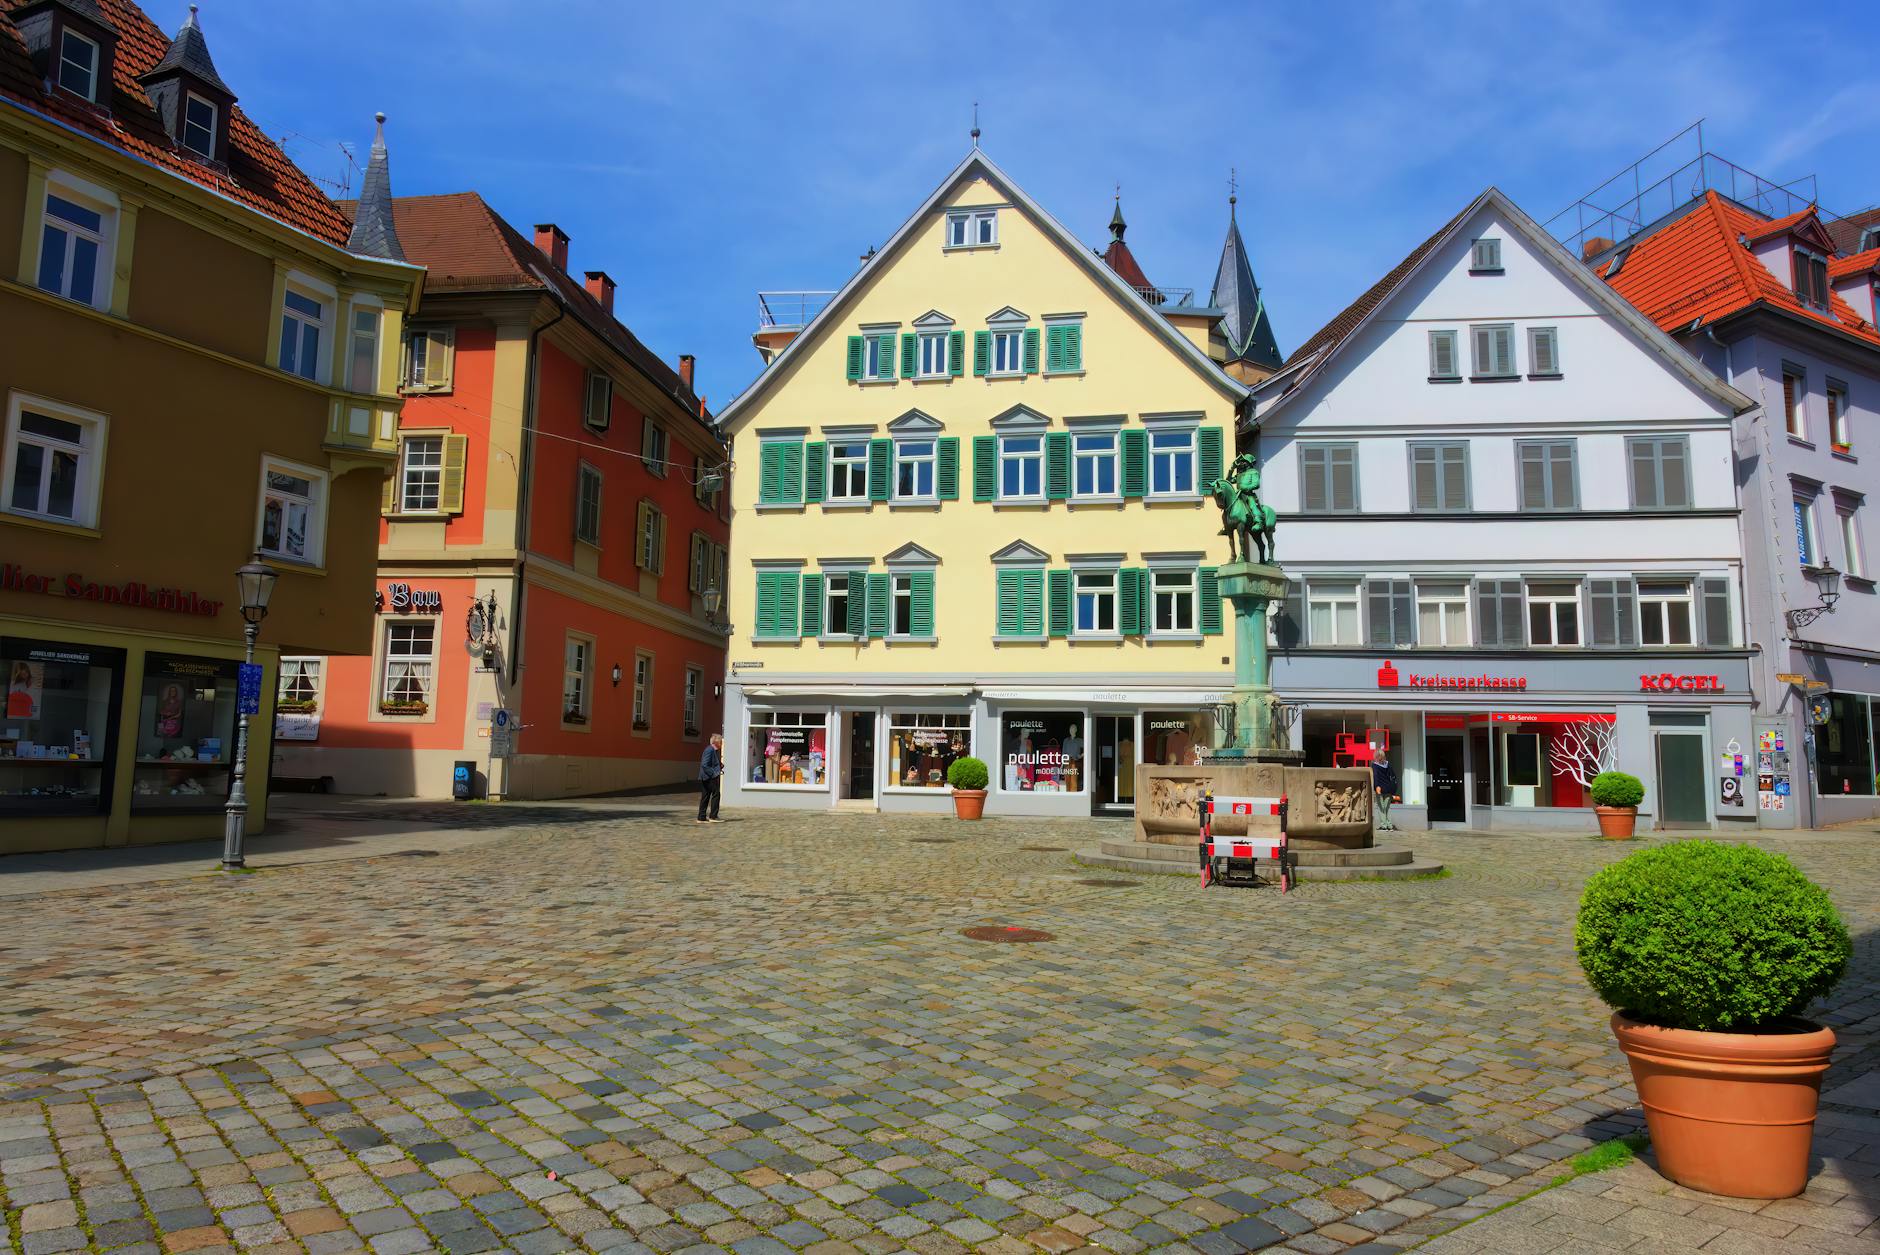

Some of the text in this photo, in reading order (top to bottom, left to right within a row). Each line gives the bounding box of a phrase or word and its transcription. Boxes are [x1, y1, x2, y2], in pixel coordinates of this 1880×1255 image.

[1794, 506, 1806, 560] Nachhilfe
[64, 573, 224, 617] Sandkühler
[1409, 673, 1527, 689] Kreissparkasse
[1640, 673, 1725, 689] KÖGEL
[1010, 720, 1043, 729] paulette
[1150, 720, 1185, 729] paulette
[1727, 737, 1741, 754] 6
[1008, 750, 1070, 766] paulette
